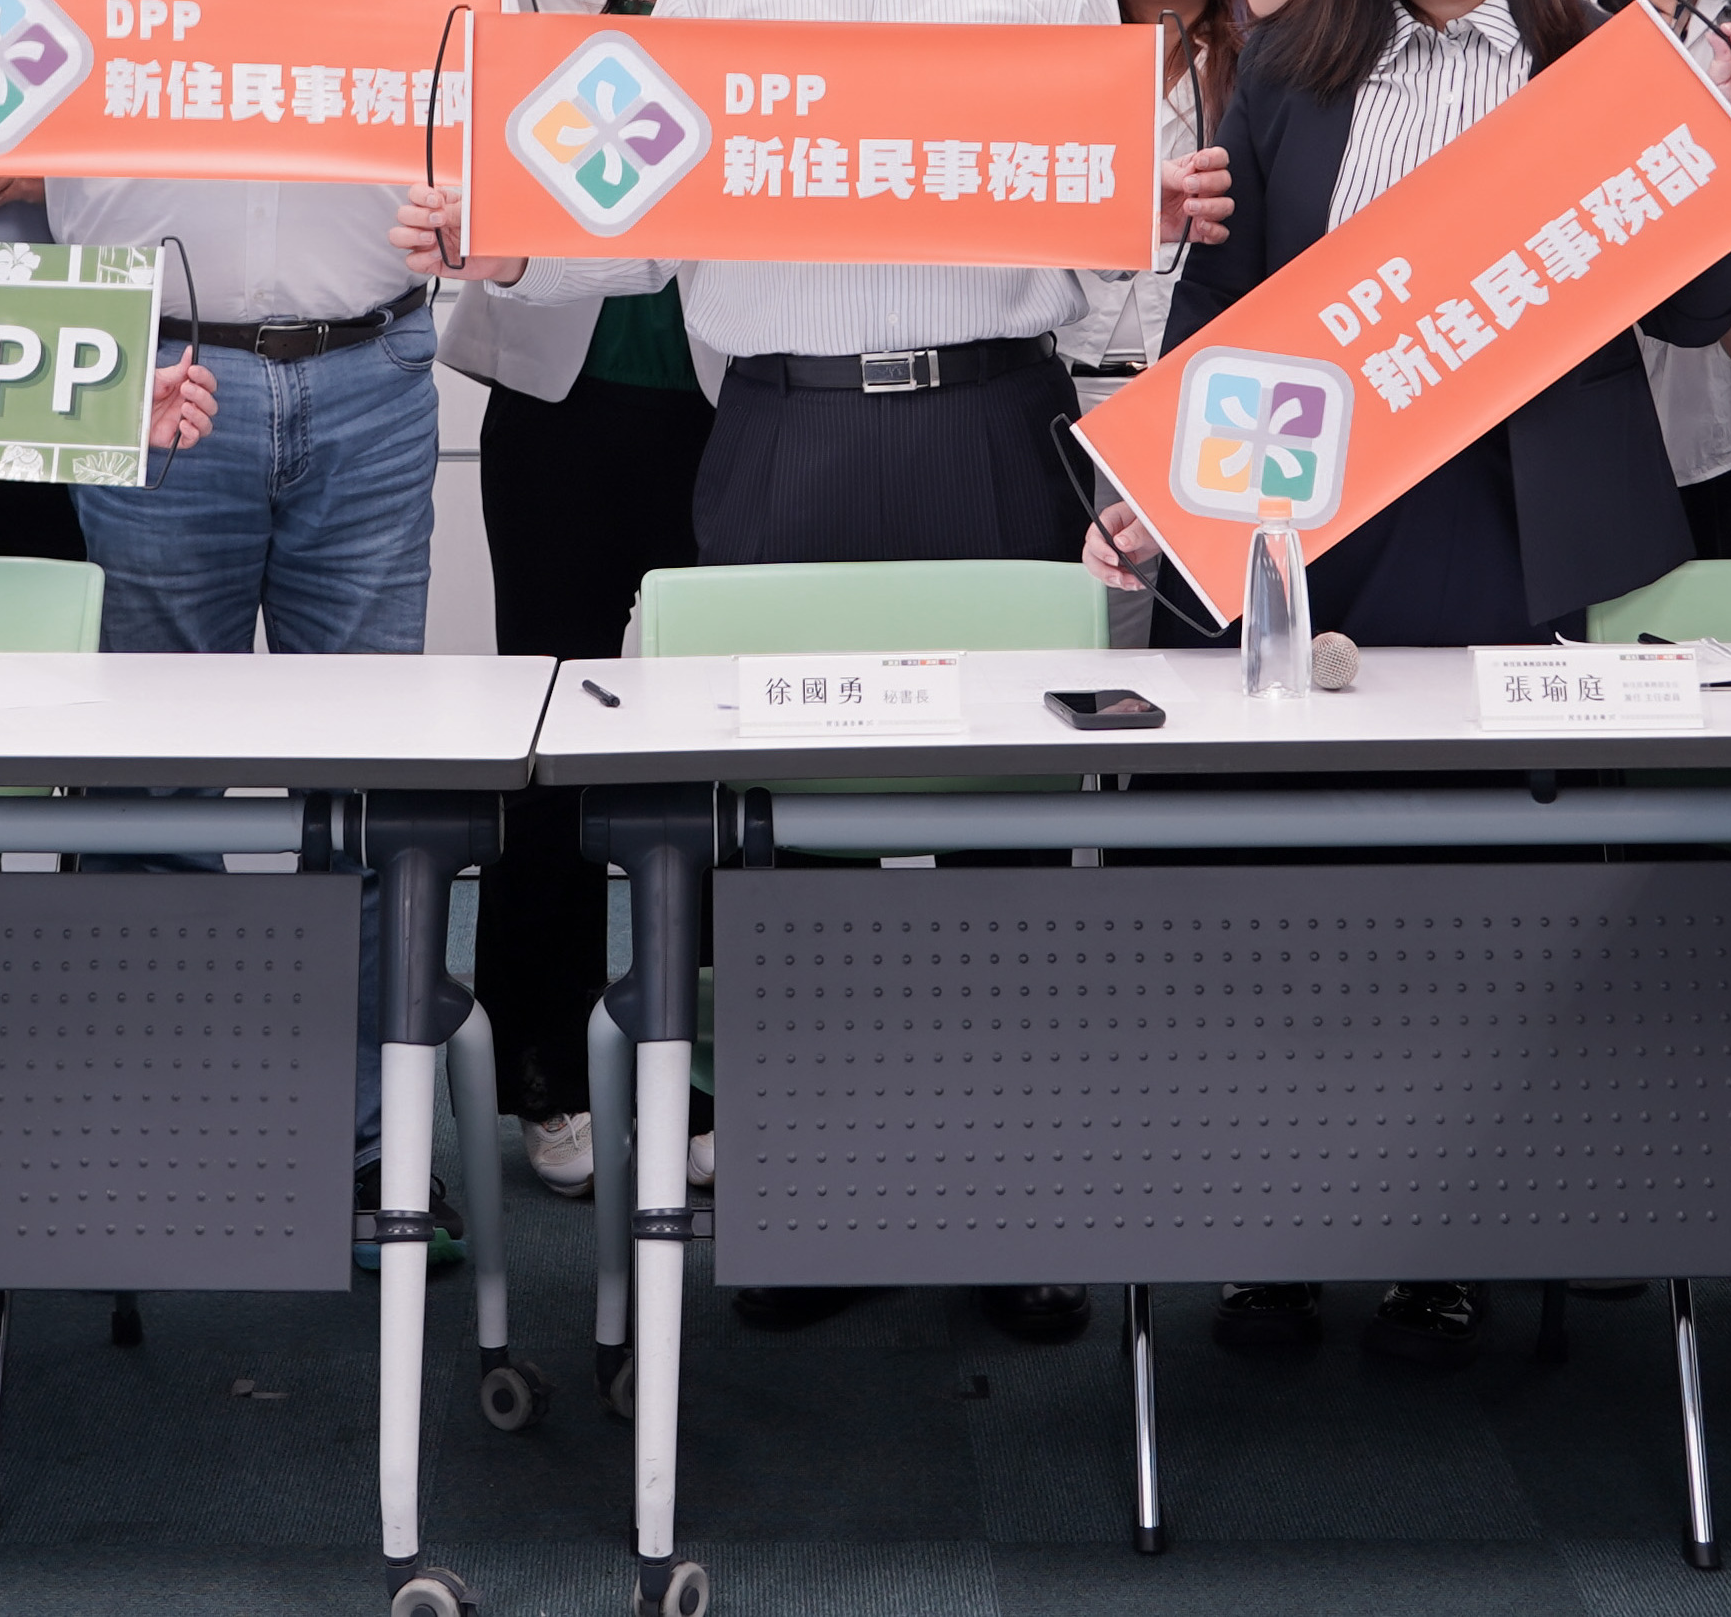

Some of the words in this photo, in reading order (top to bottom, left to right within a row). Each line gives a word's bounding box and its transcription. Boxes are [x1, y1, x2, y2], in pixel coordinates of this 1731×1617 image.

[104, 58, 466, 127] 新住民事務部
[725, 73, 826, 116] DPP
[723, 135, 1117, 204] 新住民事務部
[1317, 255, 1414, 347] DPP
[1361, 122, 1719, 413] 新住民事務部
[766, 676, 862, 705] 徐國勇
[883, 689, 930, 705] 秘書長
[1504, 674, 1604, 702] 張瑜庭
